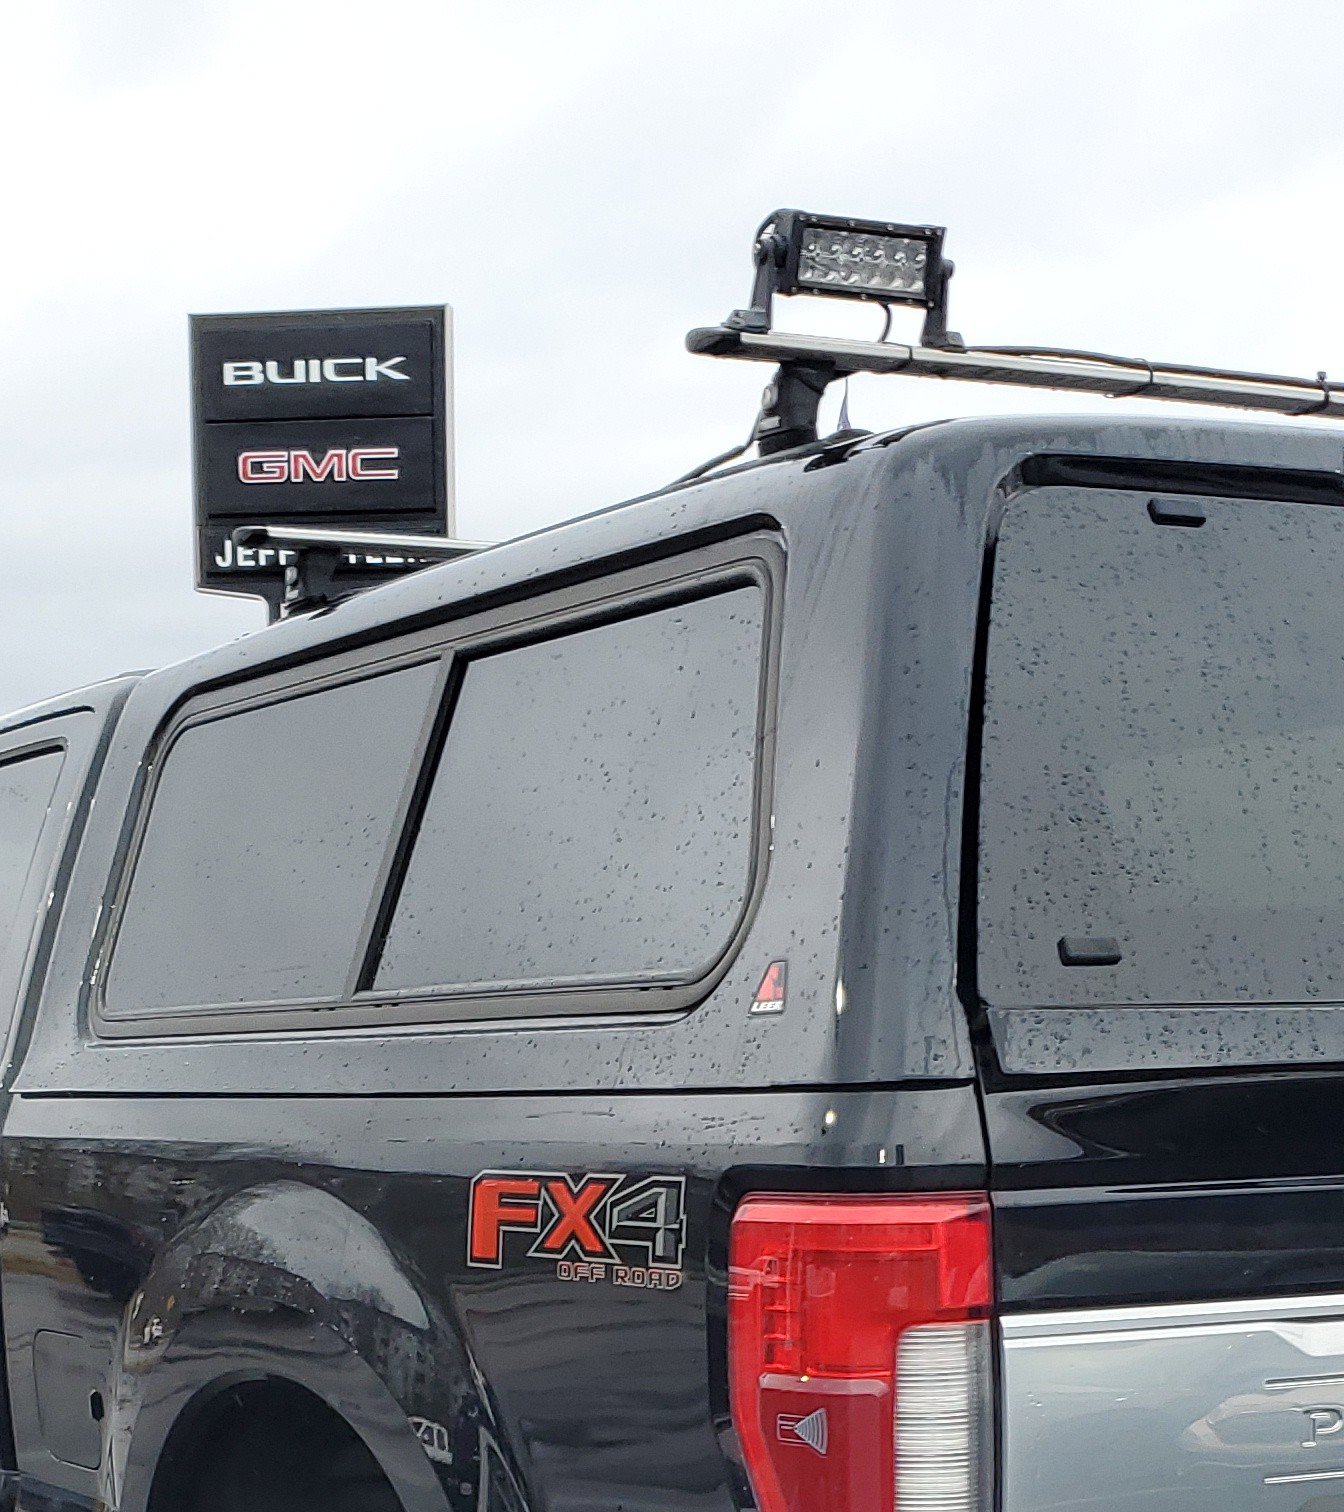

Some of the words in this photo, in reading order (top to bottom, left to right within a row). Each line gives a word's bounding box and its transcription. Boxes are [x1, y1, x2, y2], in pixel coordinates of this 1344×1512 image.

[223, 356, 410, 386] BUICK
[238, 447, 399, 483] GMC
[467, 1169, 686, 1269] FX4
[557, 1262, 606, 1283] OFF
[612, 1266, 684, 1290] ROAD
